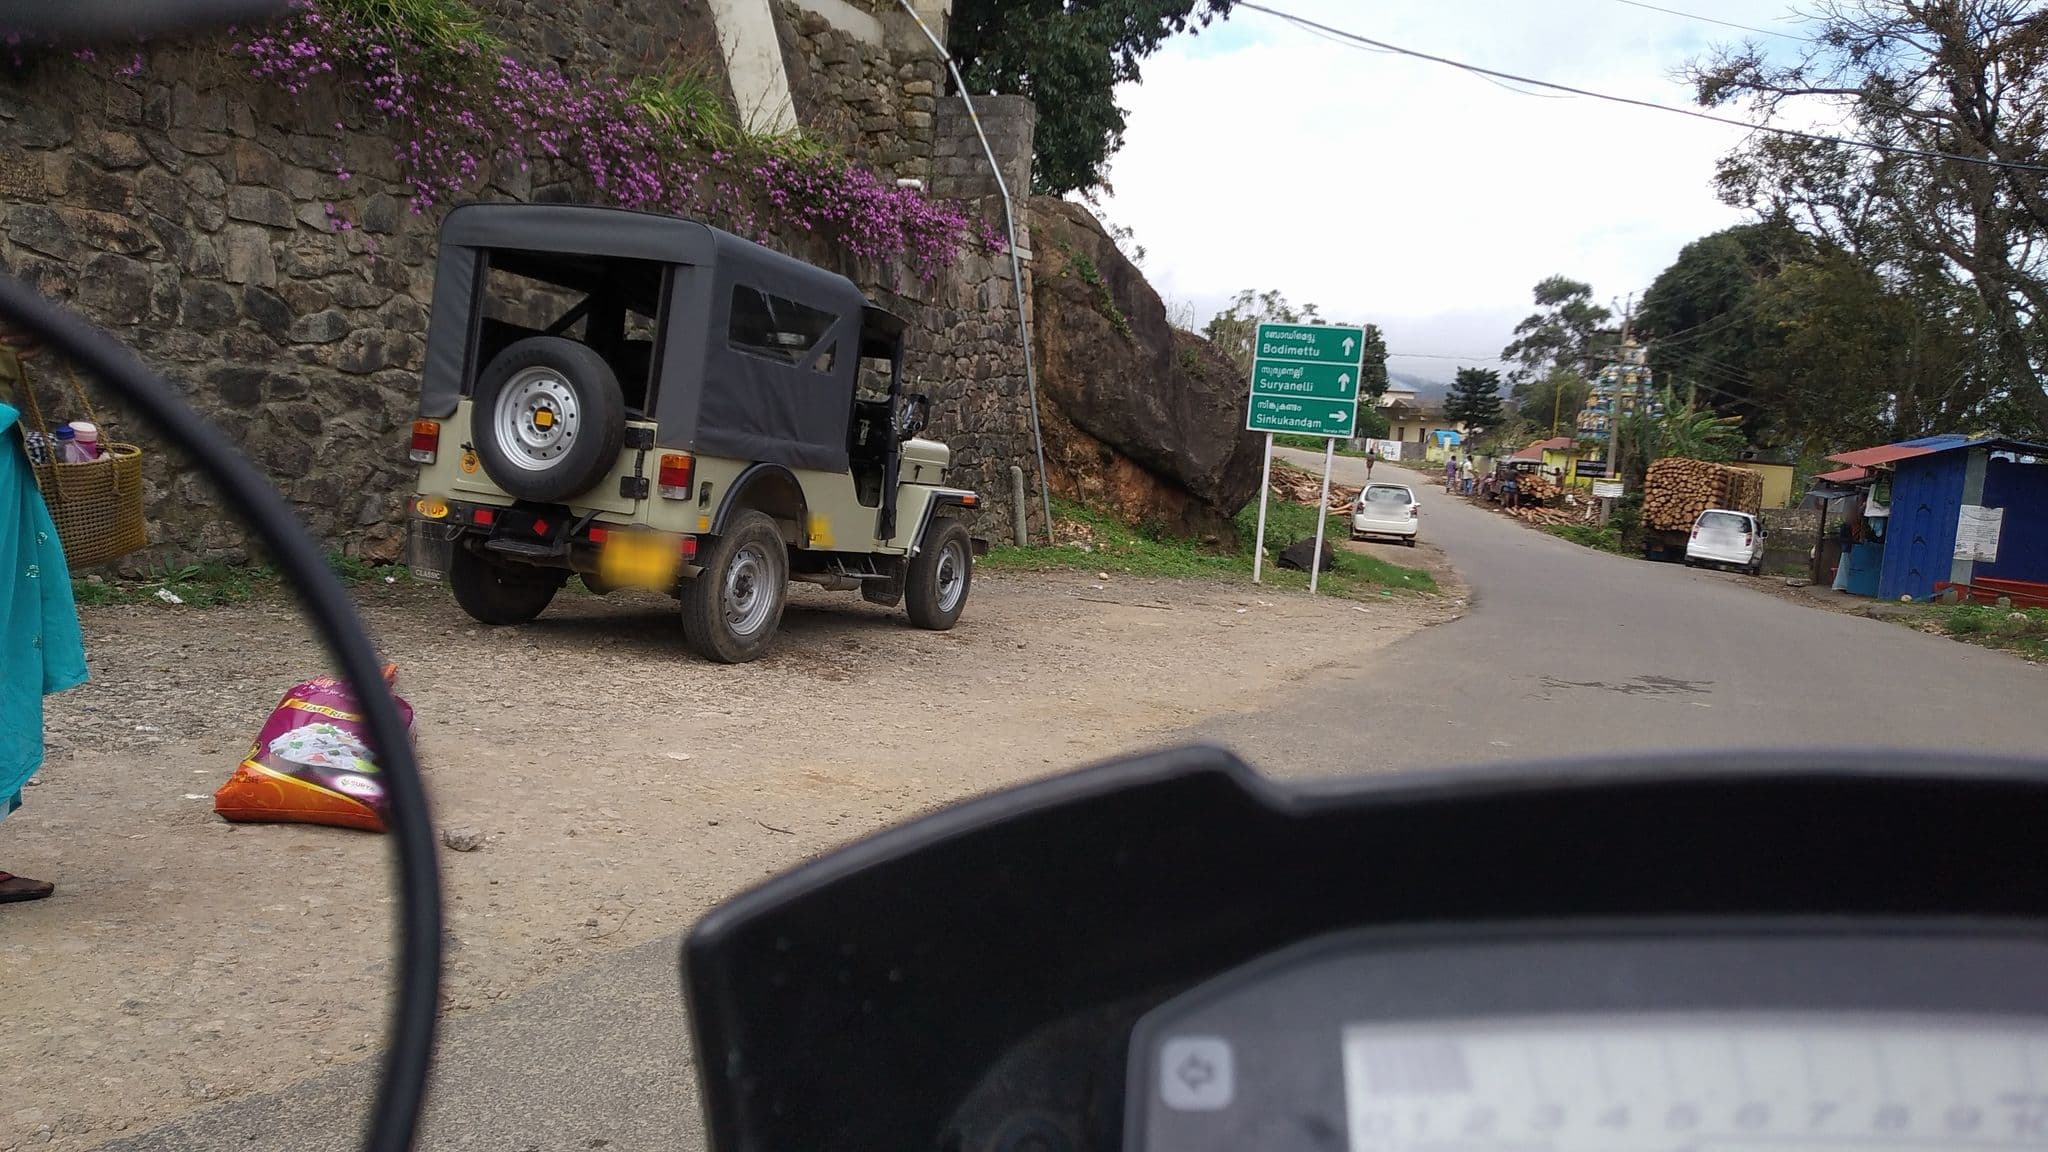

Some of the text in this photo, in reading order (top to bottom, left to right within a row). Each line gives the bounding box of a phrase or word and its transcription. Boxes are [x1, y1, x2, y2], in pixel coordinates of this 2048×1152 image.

[1263, 344, 1320, 356] Bodimettu
[1259, 378, 1313, 391] Suryanelli
[1256, 413, 1322, 428] Sinkukandam
[415, 569, 441, 580] CLASSIC
[1529, 1101, 1567, 1132] 3
[1596, 1102, 1630, 1132] 4
[1663, 1101, 1702, 1132] 5
[1732, 1101, 1773, 1131] 6
[1806, 1101, 1840, 1131] 7
[1872, 1102, 1911, 1131] 8
[1943, 1102, 1983, 1132] 9
